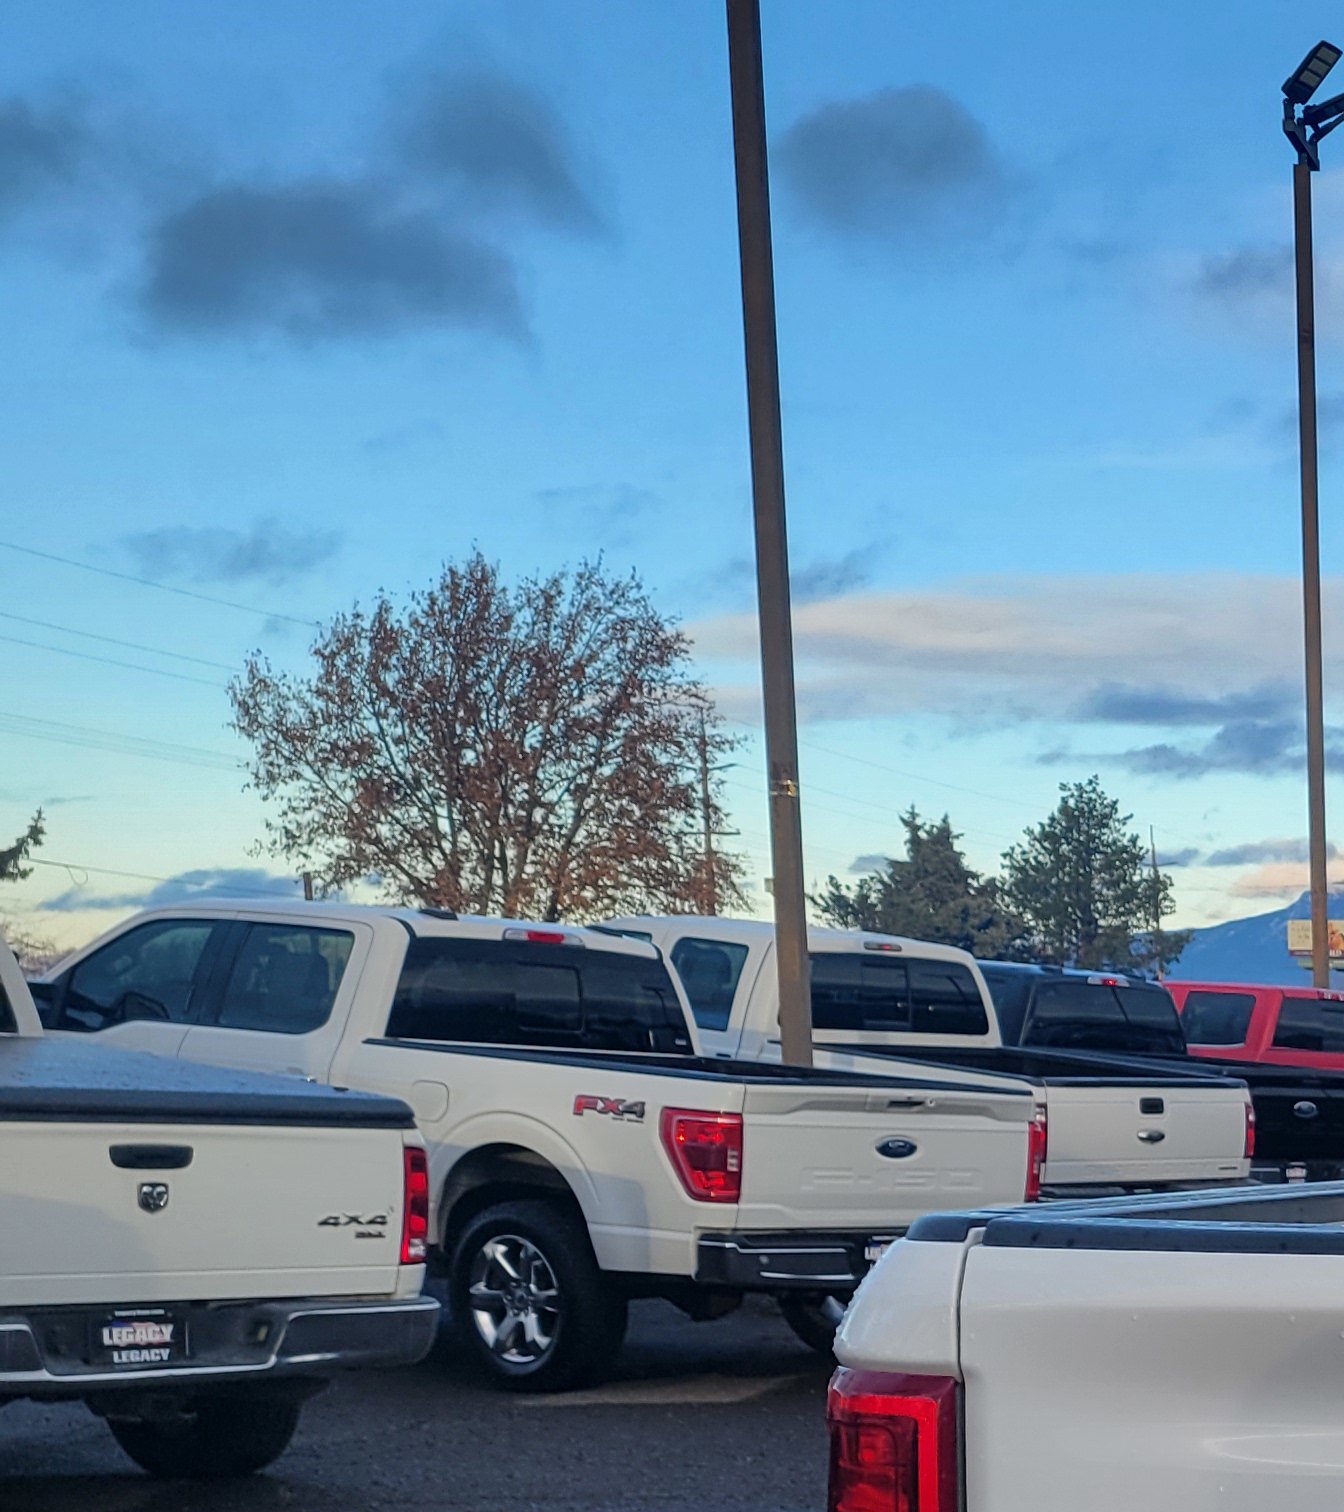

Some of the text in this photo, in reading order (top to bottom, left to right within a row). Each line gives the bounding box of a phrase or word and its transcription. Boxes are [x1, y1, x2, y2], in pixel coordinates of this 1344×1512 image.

[573, 1095, 646, 1118] FX4
[102, 1324, 174, 1346] LEGACY
[113, 1348, 171, 1363] LEGACY
